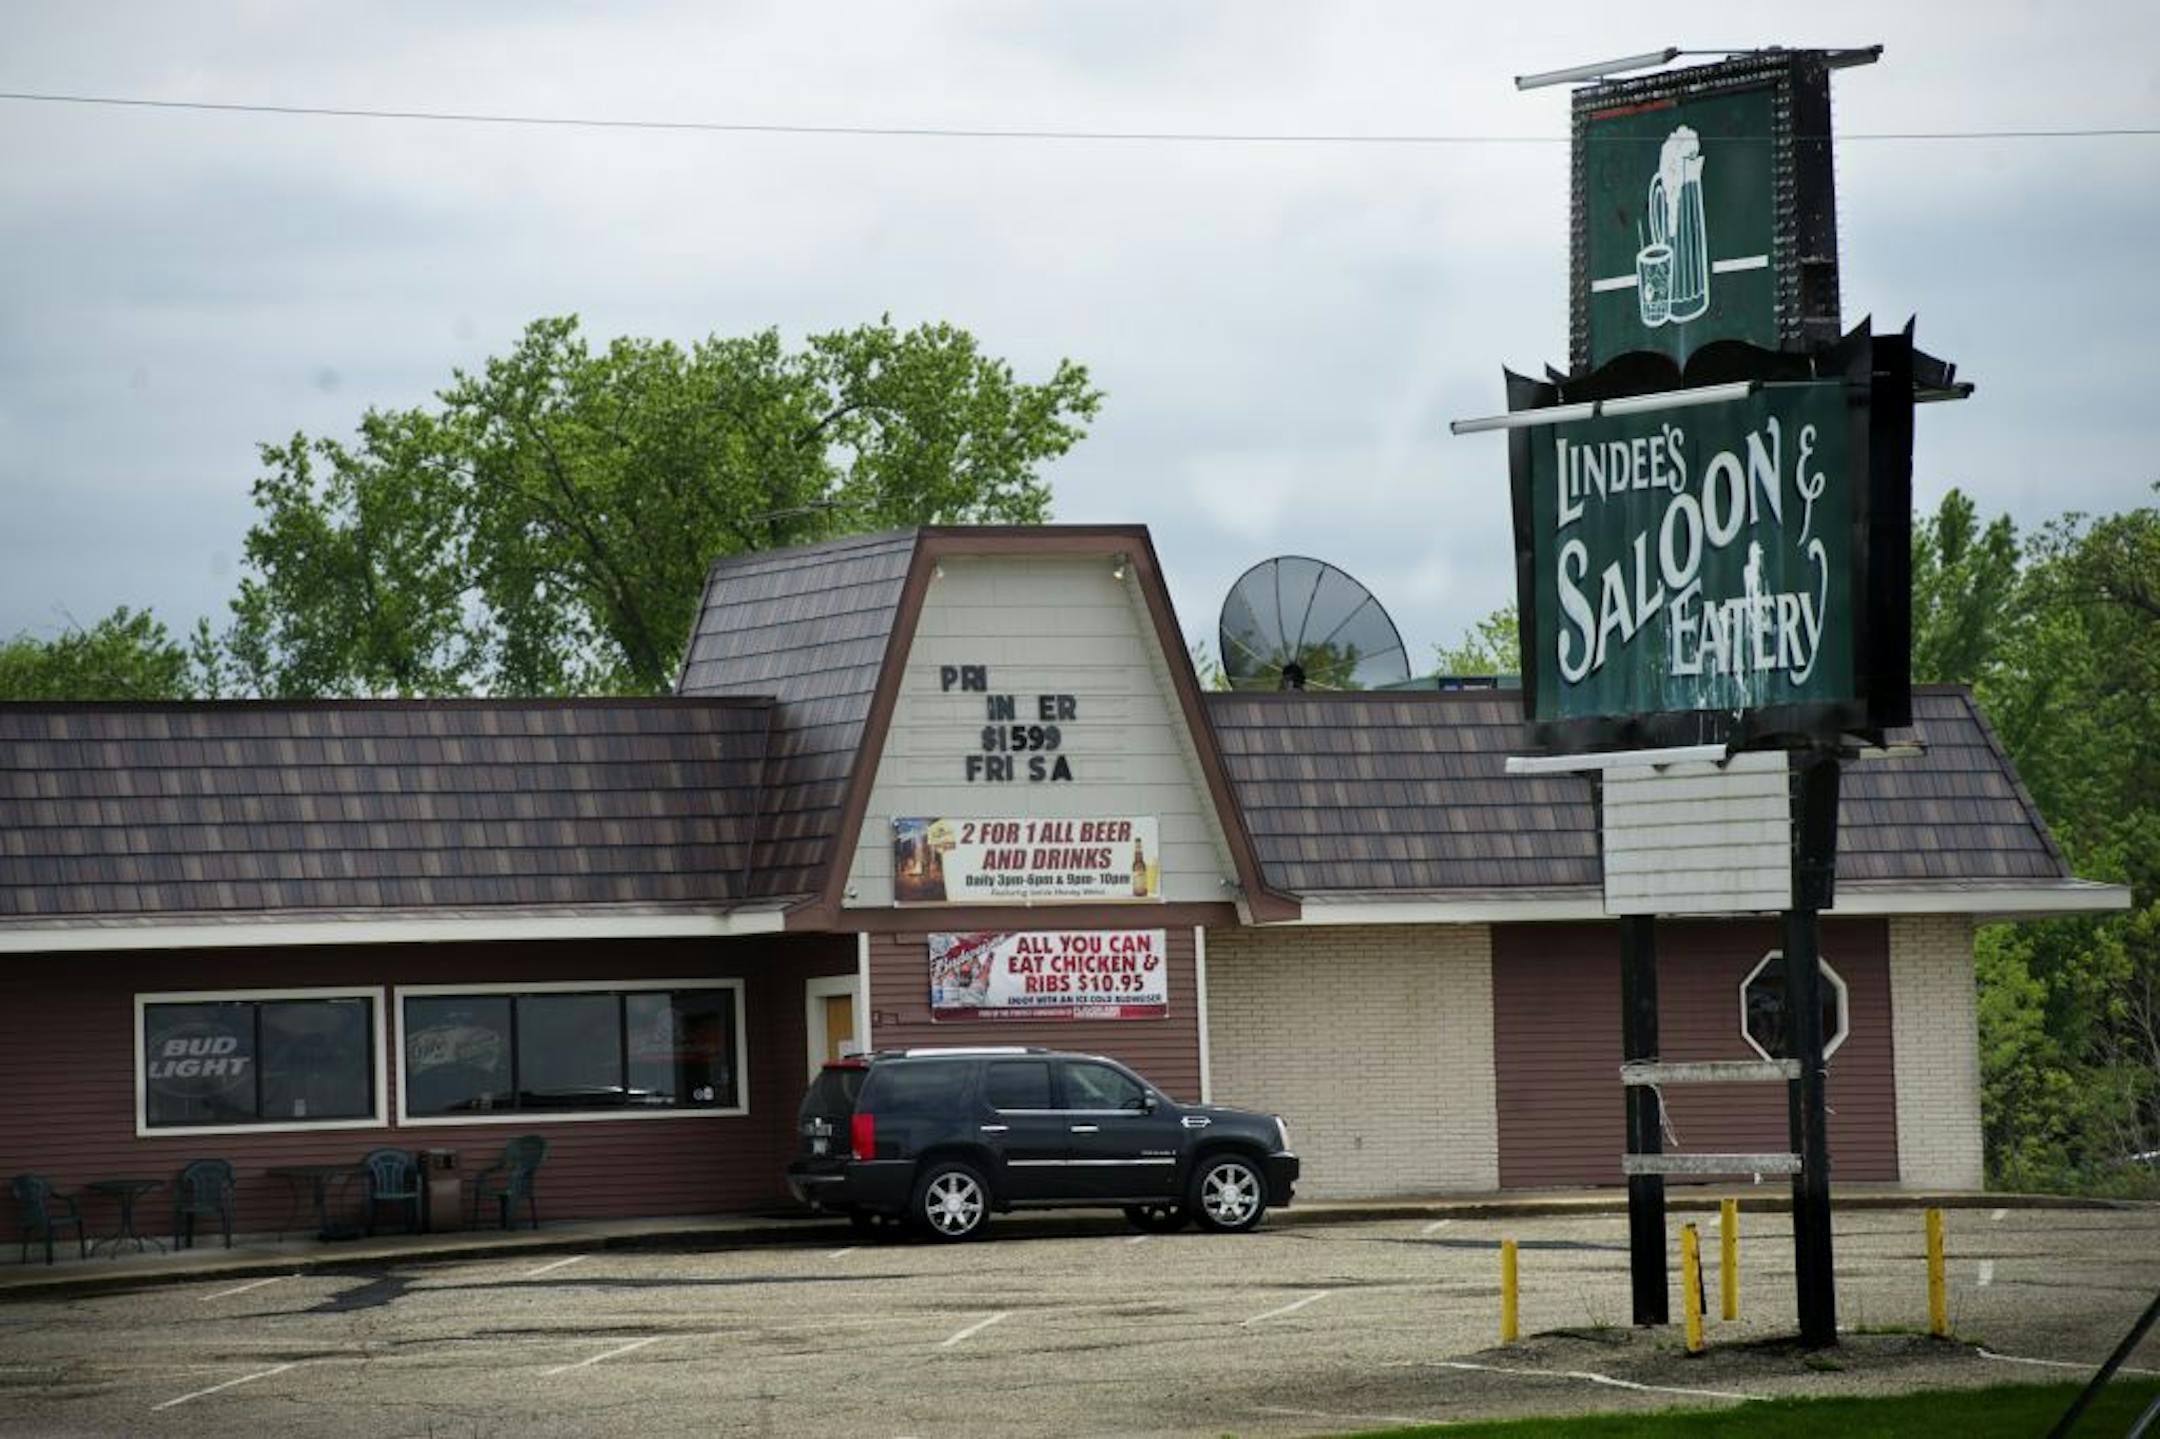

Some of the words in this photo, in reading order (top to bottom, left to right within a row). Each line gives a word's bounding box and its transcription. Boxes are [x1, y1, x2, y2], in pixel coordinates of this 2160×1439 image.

[1556, 422, 1687, 529] LINDEE'S
[1557, 416, 1783, 683] SALOON
[1669, 538, 1828, 686] EATERY
[1038, 694, 1077, 721] ER
[966, 755, 1013, 782] FRI
[960, 823, 975, 844] 2
[980, 822, 1020, 843] FOR
[1026, 822, 1036, 843] 1
[1040, 822, 1075, 843] ALL
[1080, 821, 1132, 842] BEER
[983, 849, 1027, 870] AND
[1032, 848, 1112, 870] DRINKS
[966, 874, 994, 887] Daily
[1017, 937, 1053, 954] ALL
[1060, 936, 1101, 953] YOU
[1109, 935, 1152, 952] CAN
[1008, 956, 1044, 974] EAT
[1051, 955, 1136, 973] CHICKEN
[1143, 954, 1159, 971] &
[1025, 976, 1070, 993] RIBS
[1078, 975, 1144, 993] $10.95
[163, 1037, 238, 1057] BUD
[148, 1057, 250, 1079] LIGHT
